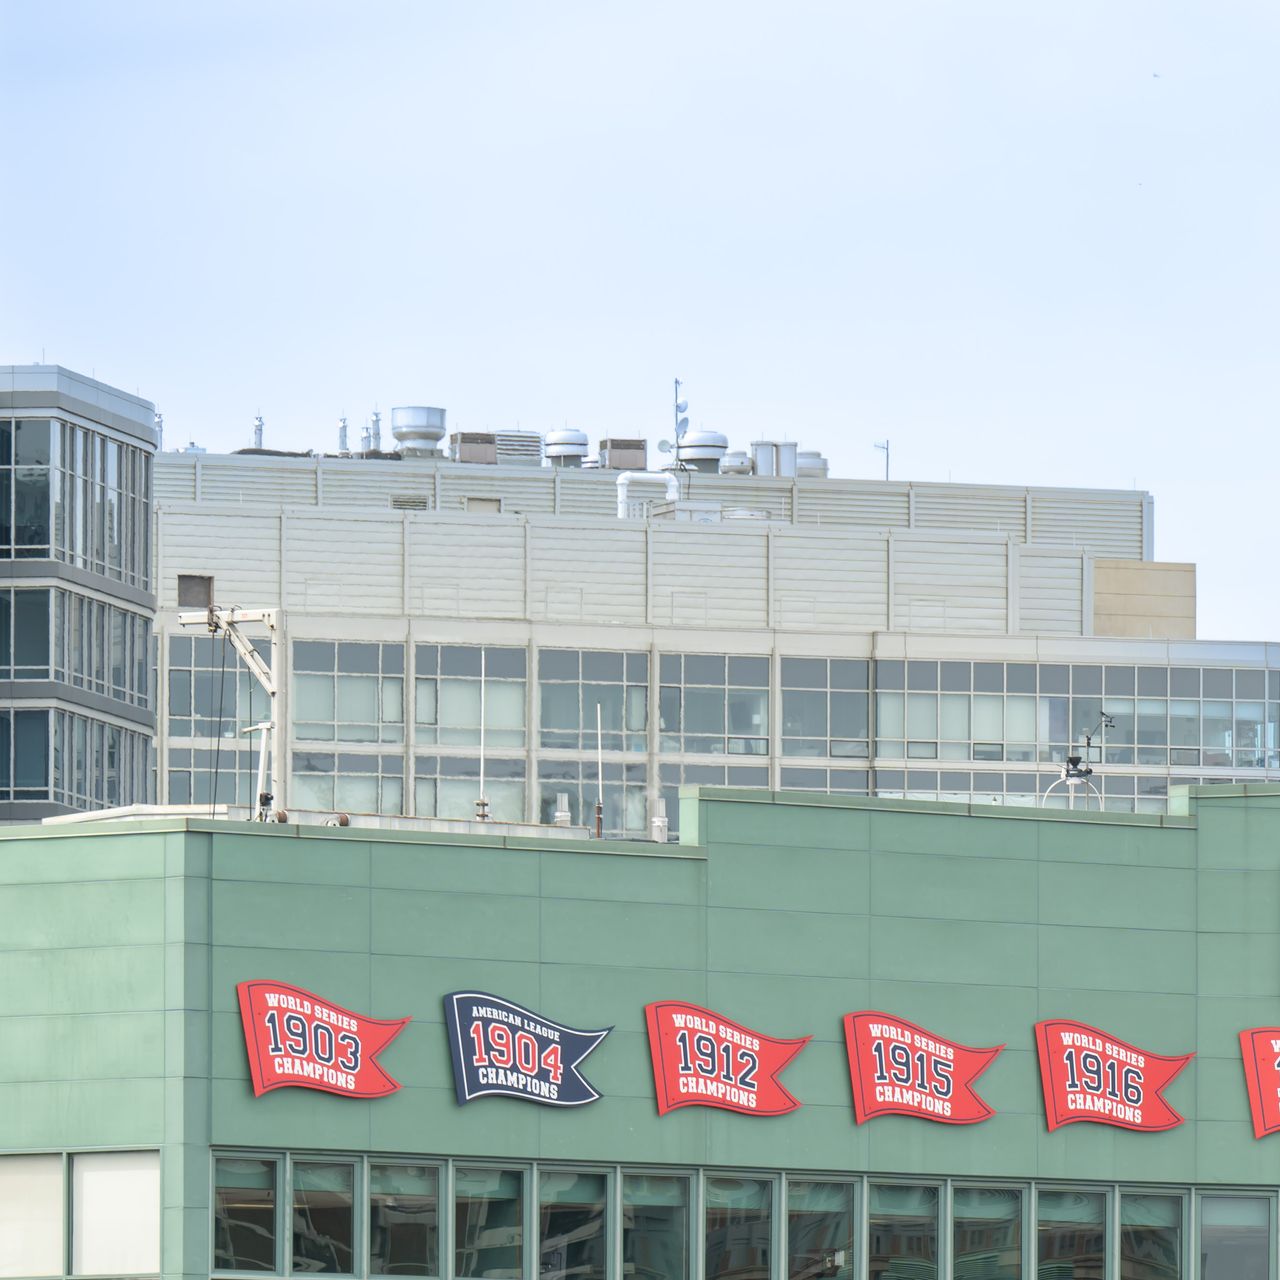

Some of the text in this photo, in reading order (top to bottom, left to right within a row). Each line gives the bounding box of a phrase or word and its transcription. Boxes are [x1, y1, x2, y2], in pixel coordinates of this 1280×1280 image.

[265, 993, 357, 1031] WORLD SERIES
[472, 1006, 560, 1041] AMERICAN LEAGUE
[265, 1010, 362, 1074] 1903
[673, 1014, 759, 1050] WORLD SERIES
[869, 1024, 954, 1060] WORLD SERIES
[1061, 1032, 1145, 1068] WORLD SERIES
[470, 1021, 563, 1084] 1904
[677, 1030, 759, 1091] 1912
[872, 1040, 954, 1099] 1915
[275, 1057, 355, 1090] CHAMPIONS
[479, 1067, 558, 1100] CHAMPIONS
[1063, 1048, 1144, 1107] 1916
[679, 1077, 756, 1108] CHAMPIONS
[876, 1086, 951, 1116] CHAMPIONS
[1067, 1093, 1142, 1123] CHAMPIONS
